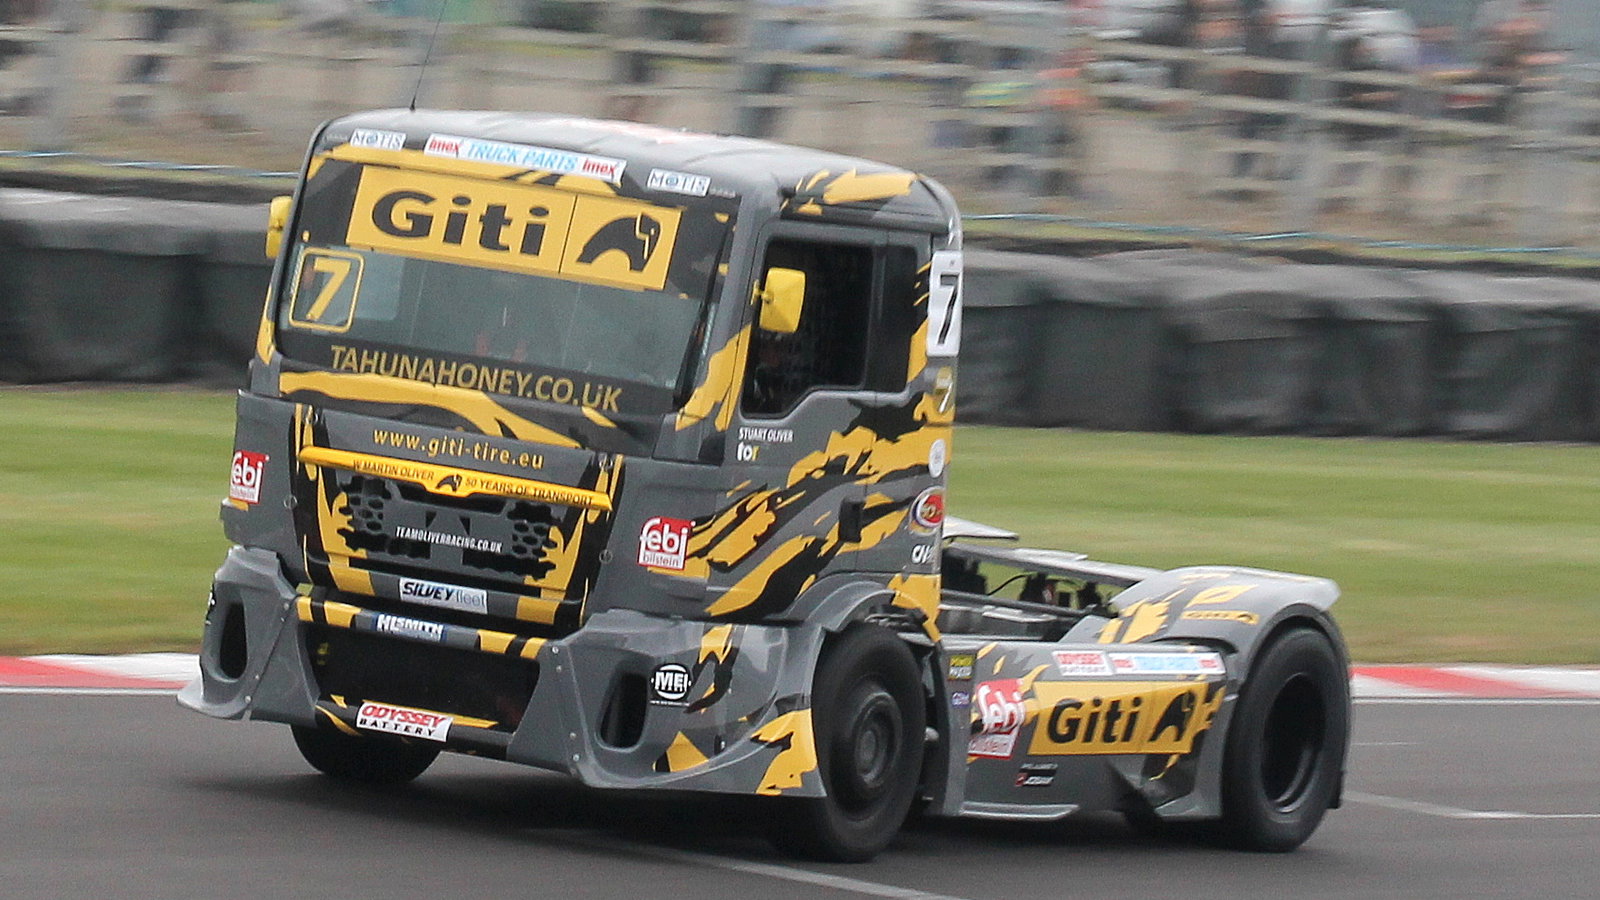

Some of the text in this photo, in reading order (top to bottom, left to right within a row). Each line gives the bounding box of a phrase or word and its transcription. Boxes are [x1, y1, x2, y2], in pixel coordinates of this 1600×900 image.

[468, 142, 517, 163] TRUCK
[522, 150, 577, 173] PARTS
[372, 190, 548, 256] Giti
[305, 256, 351, 321] 7
[937, 273, 960, 345] 7
[373, 429, 544, 470] www.giti-tire.eu
[738, 427, 794, 443] STUART OLIVER
[363, 461, 398, 476] MARTIN
[400, 466, 434, 480] OLIVER
[466, 477, 477, 487] 50
[480, 479, 513, 494] YEARS
[515, 485, 527, 496] OF
[533, 488, 594, 505] TRANSPORT
[396, 526, 503, 553] TEAMOLIVERRACING.CO.UK
[640, 518, 688, 553] febi
[642, 551, 680, 568] bilstein
[402, 582, 486, 607] SILVEY fleet
[655, 671, 688, 692] MEI
[359, 718, 436, 736] BATTERY
[362, 705, 446, 727] ODYSSEY
[1047, 697, 1142, 744] Giti
